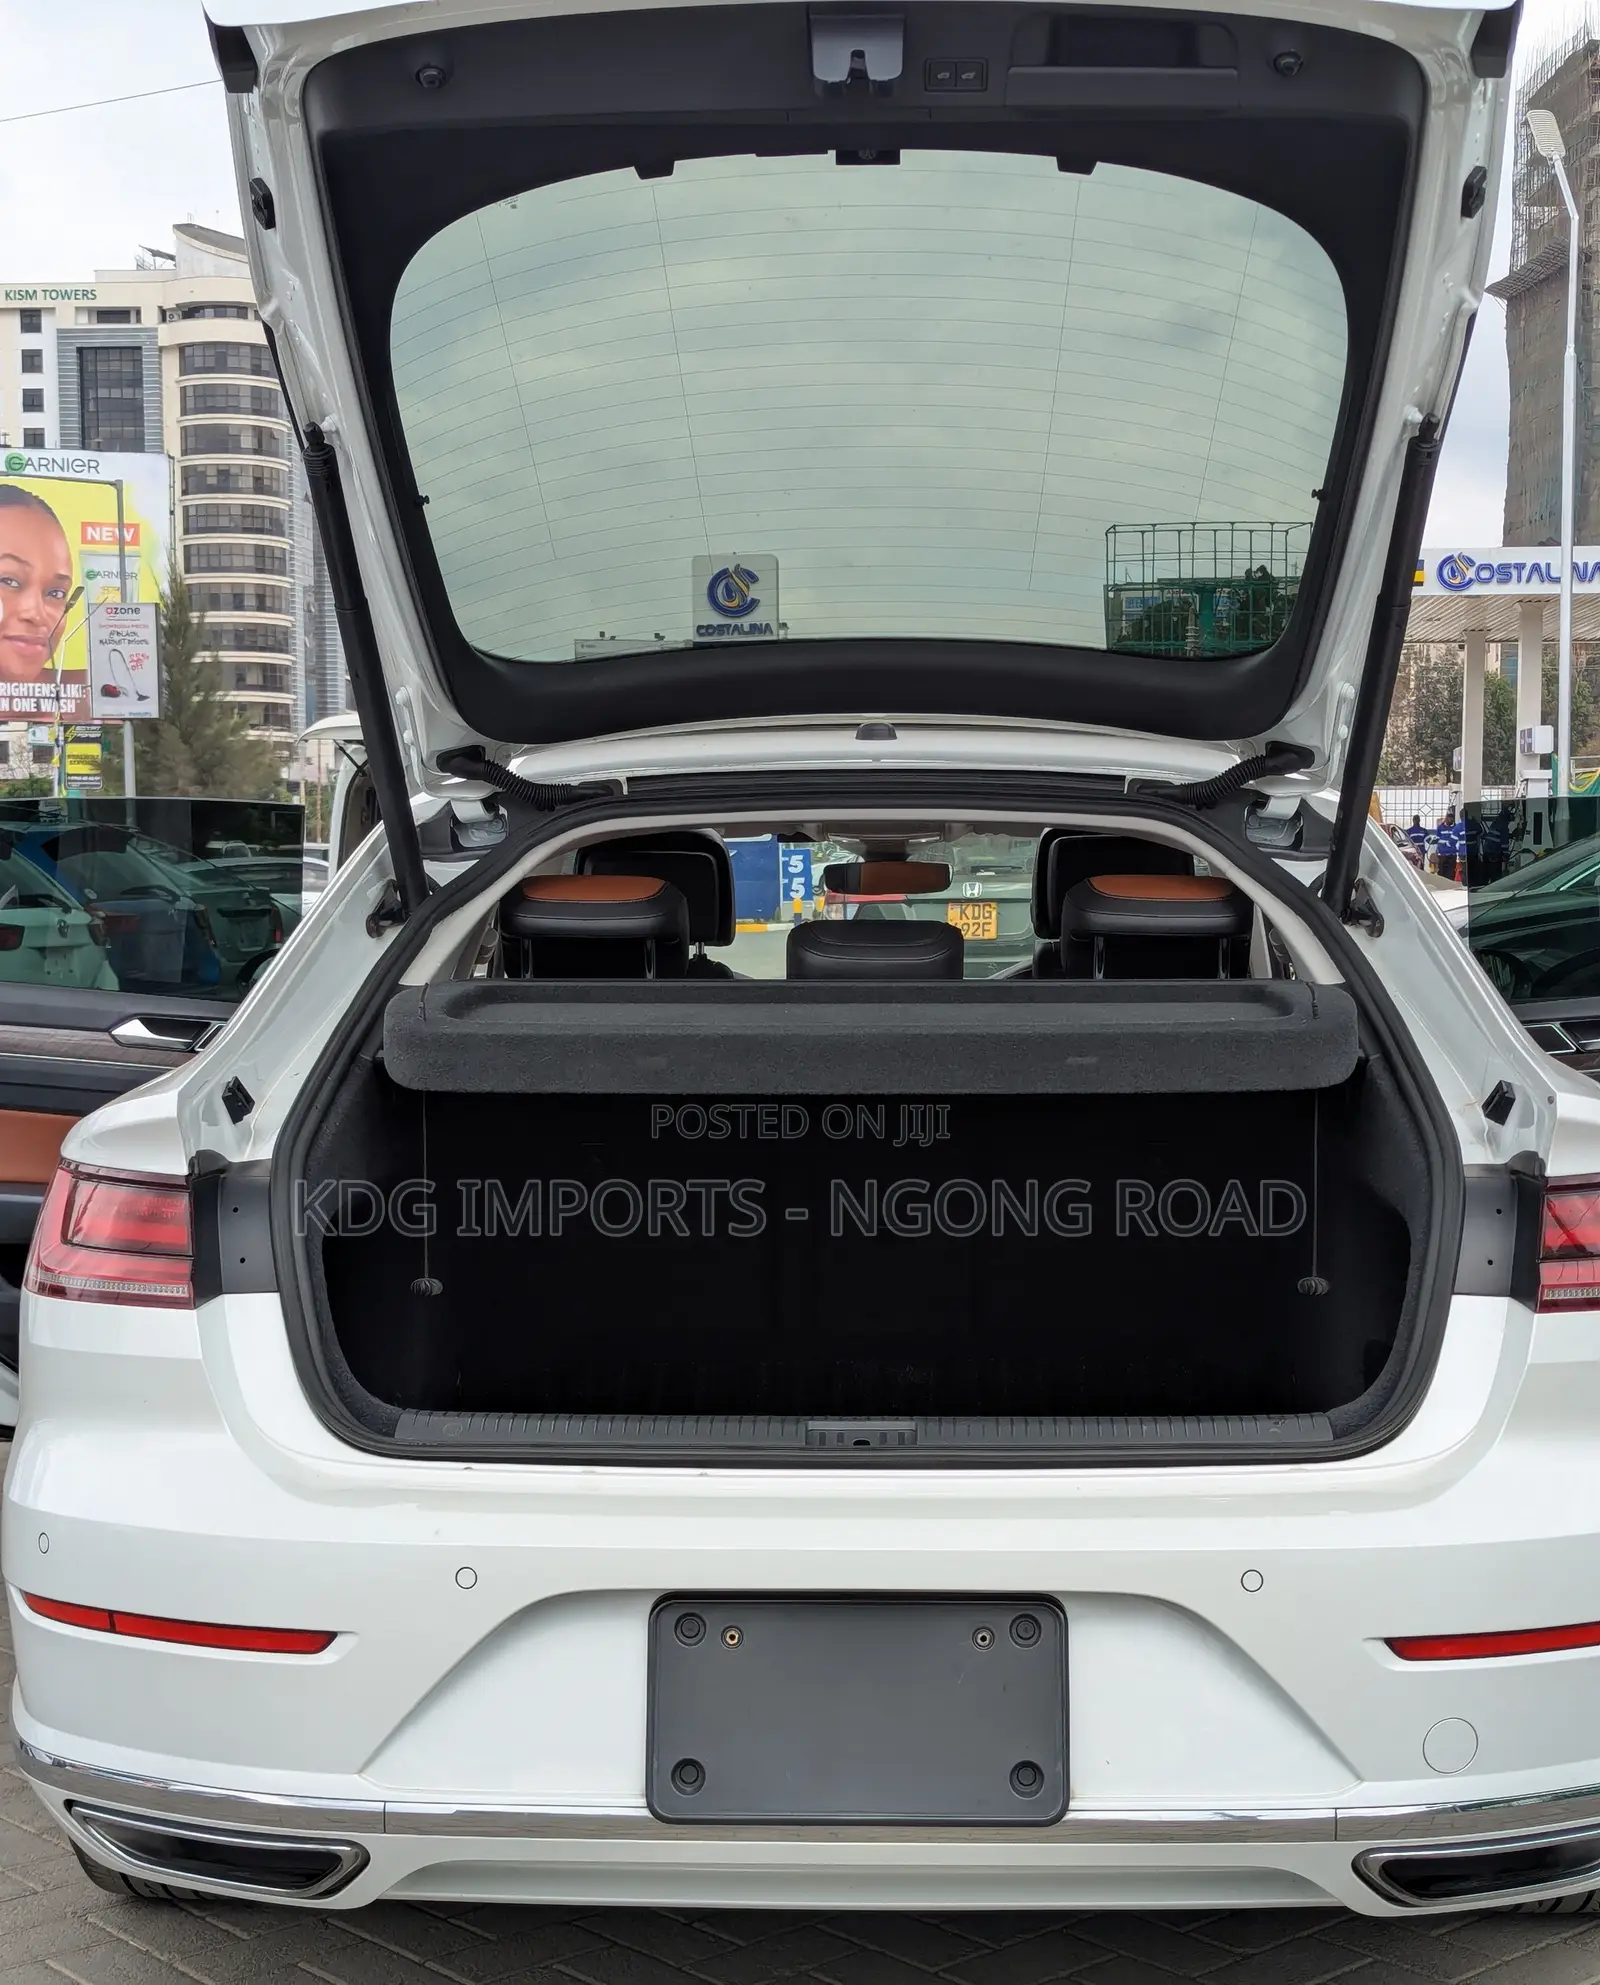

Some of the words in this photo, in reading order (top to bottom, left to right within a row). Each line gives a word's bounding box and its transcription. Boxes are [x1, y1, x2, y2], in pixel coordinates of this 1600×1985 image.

[5, 289, 37, 301] KISM
[42, 289, 97, 301] TOWERS
[5, 454, 100, 474] GARNIER
[86, 526, 135, 542] NEW
[696, 623, 774, 637] COSTALINA
[13, 698, 37, 712] ONE
[788, 855, 804, 873] 5
[790, 878, 805, 899] 5
[960, 904, 992, 920] KDG
[954, 922, 992, 937] 92F
